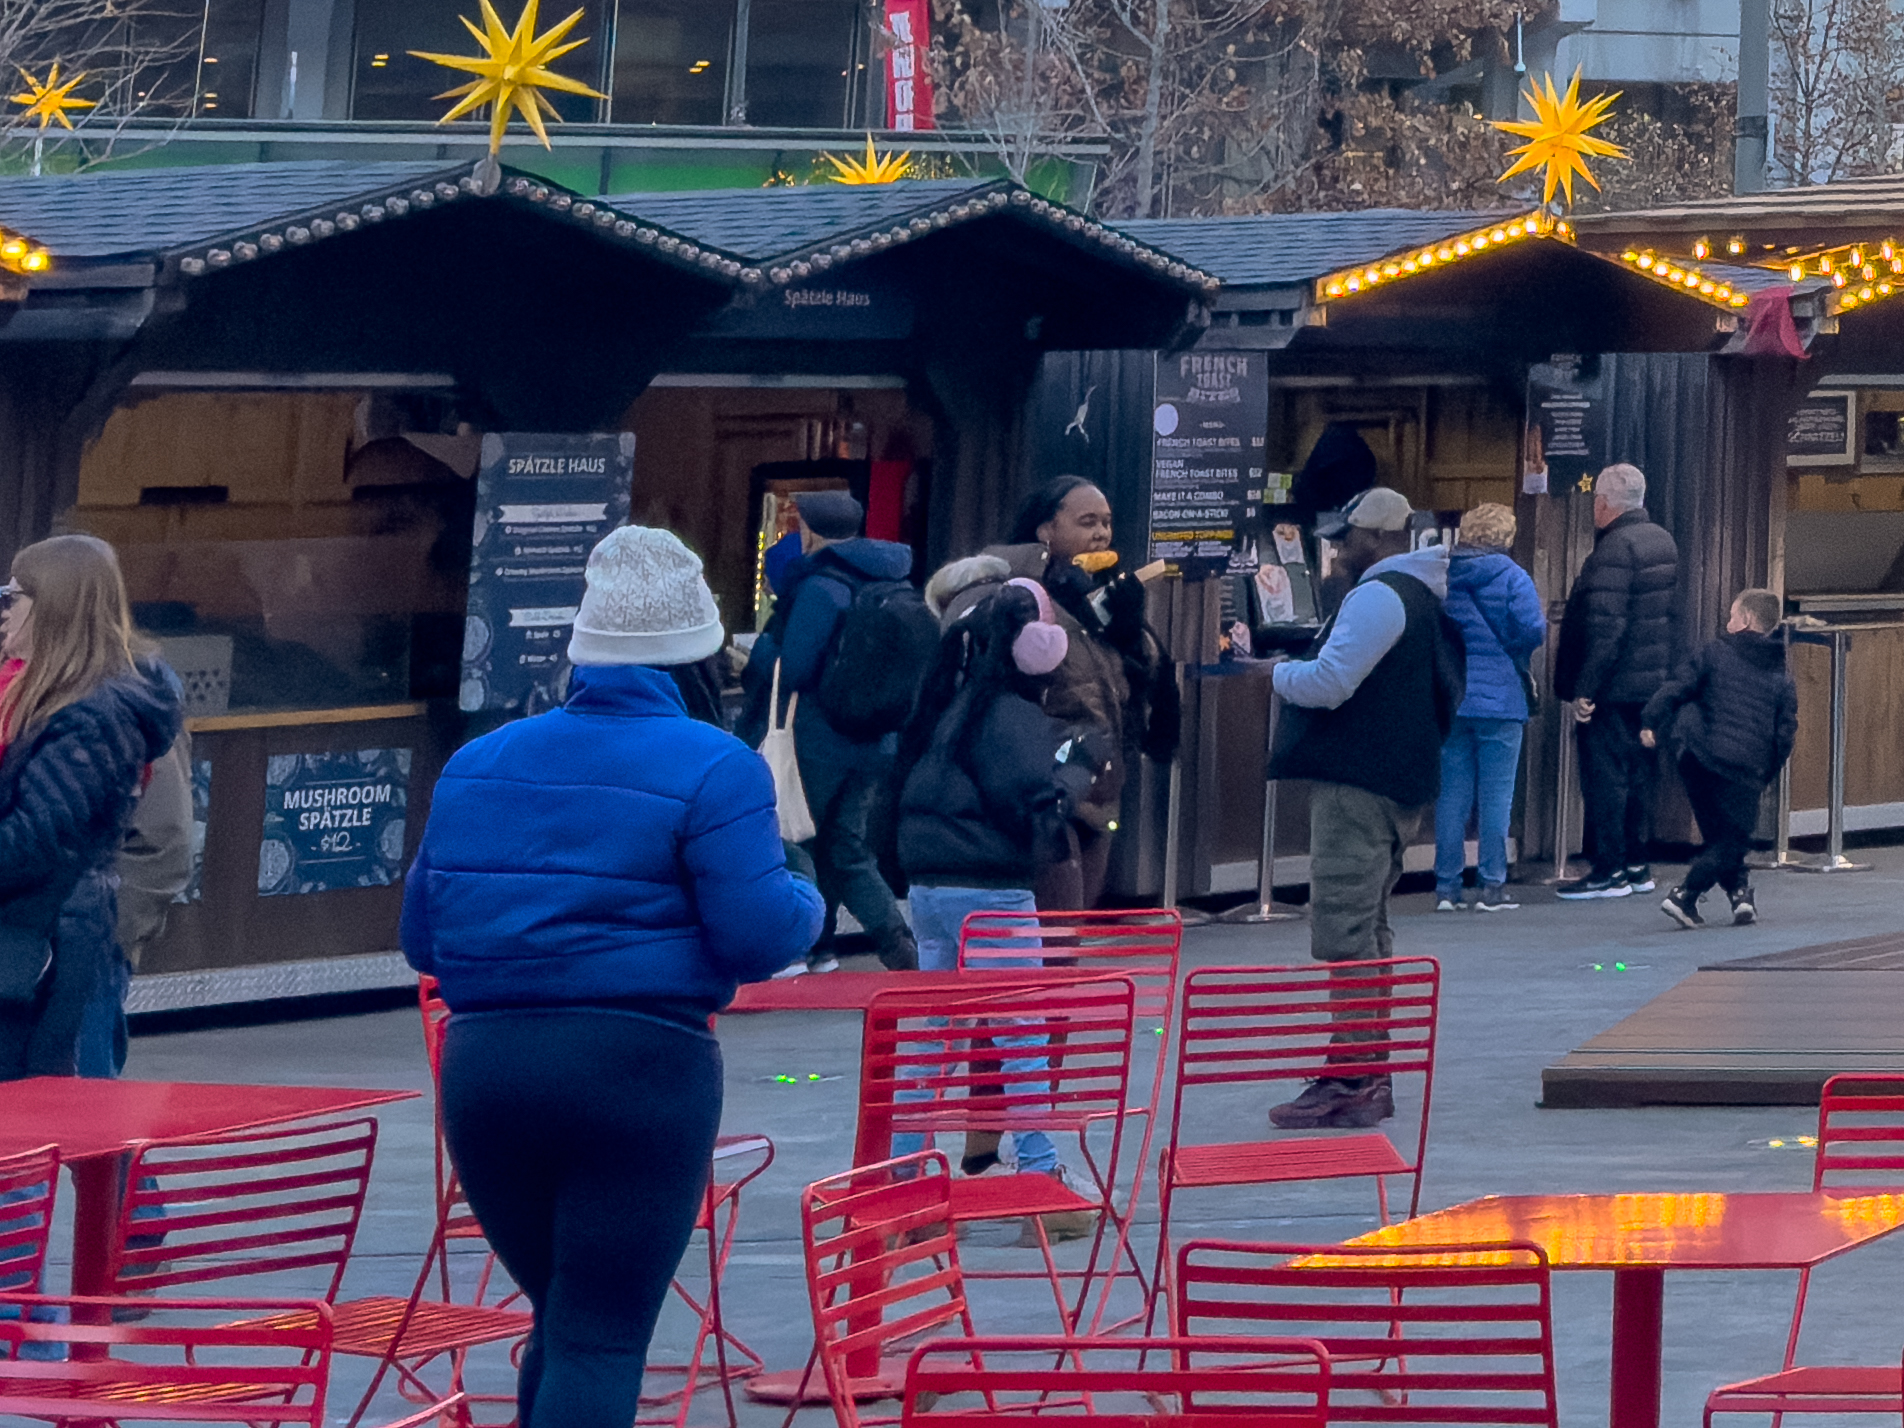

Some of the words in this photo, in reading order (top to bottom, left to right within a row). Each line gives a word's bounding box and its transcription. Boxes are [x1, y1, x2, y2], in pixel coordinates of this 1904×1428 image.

[1180, 354, 1248, 377] FRENCH
[568, 457, 606, 474] HAUS
[283, 783, 392, 810] MUSHROOM
[298, 806, 372, 831] SPÄTZLE
[320, 831, 353, 851] $12
